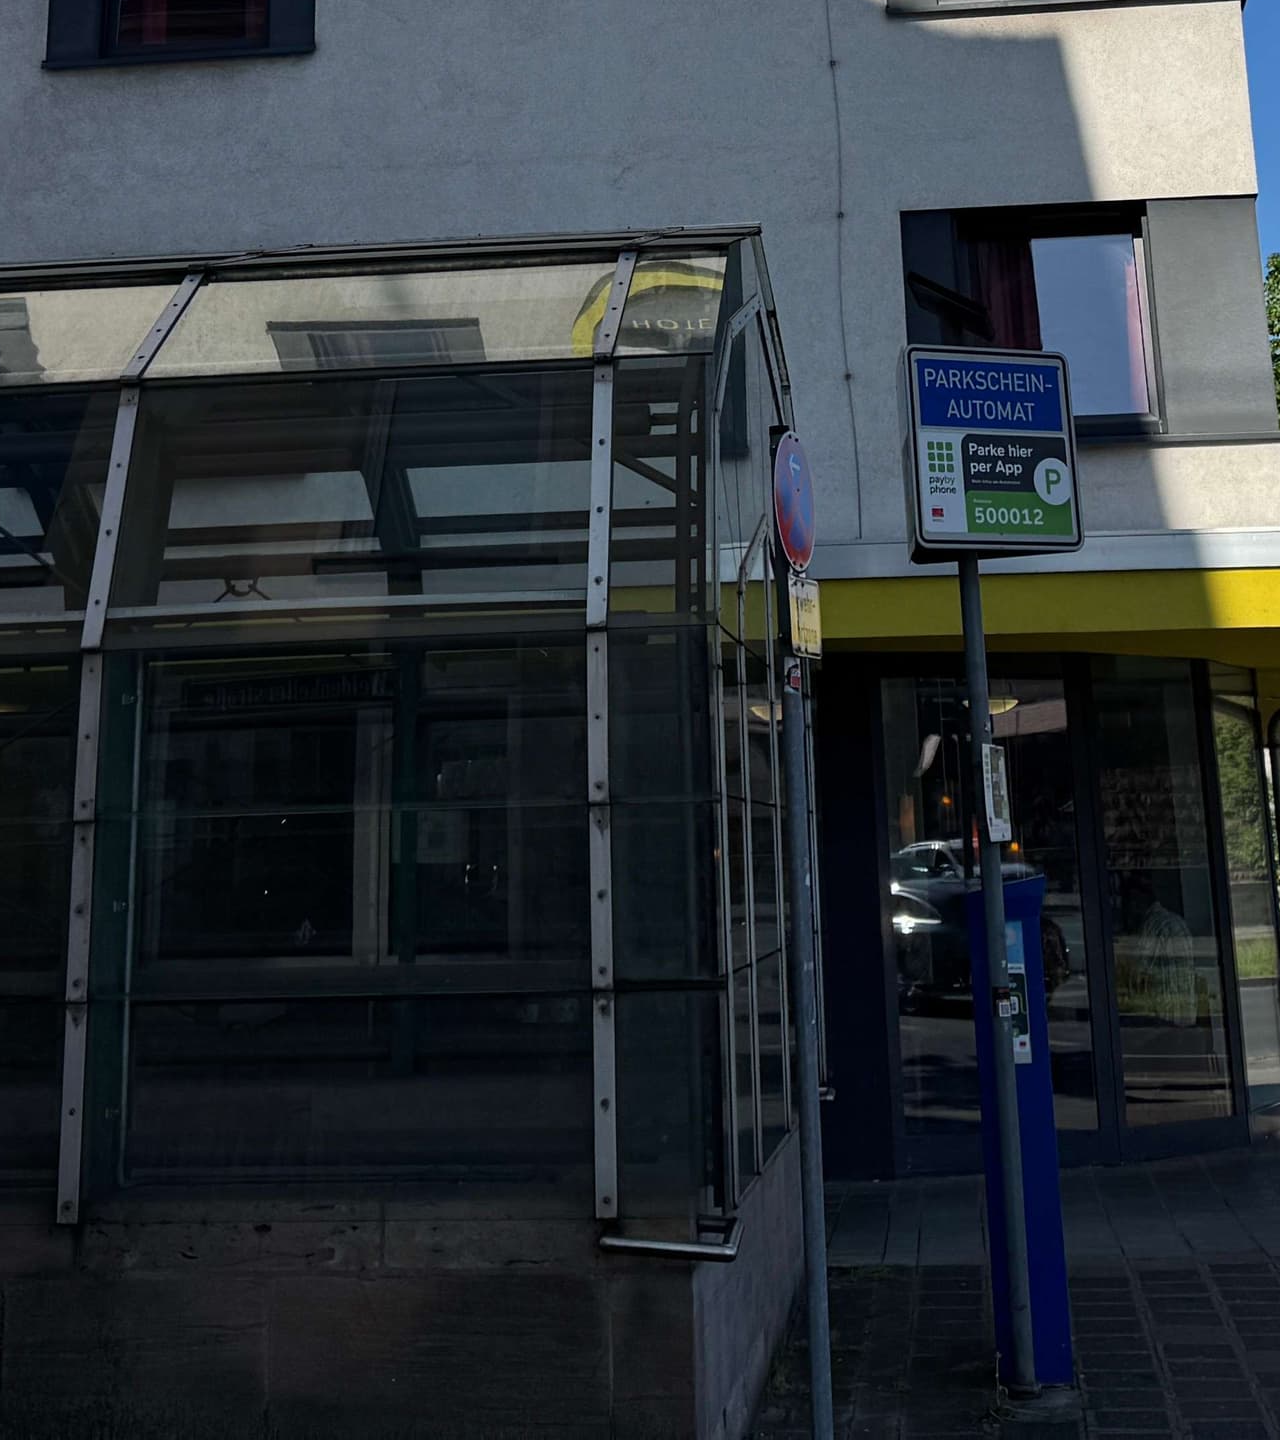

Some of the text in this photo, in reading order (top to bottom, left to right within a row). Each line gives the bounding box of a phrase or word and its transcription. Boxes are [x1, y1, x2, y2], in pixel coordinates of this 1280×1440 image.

[923, 367, 1053, 394] PARKSCHEIN-
[946, 398, 1036, 422] AUTOMAT
[968, 442, 1034, 458] Parke hier
[970, 460, 1023, 476] per App
[929, 485, 957, 495] phone
[1044, 468, 1062, 495] P
[975, 507, 1045, 526] 500012
